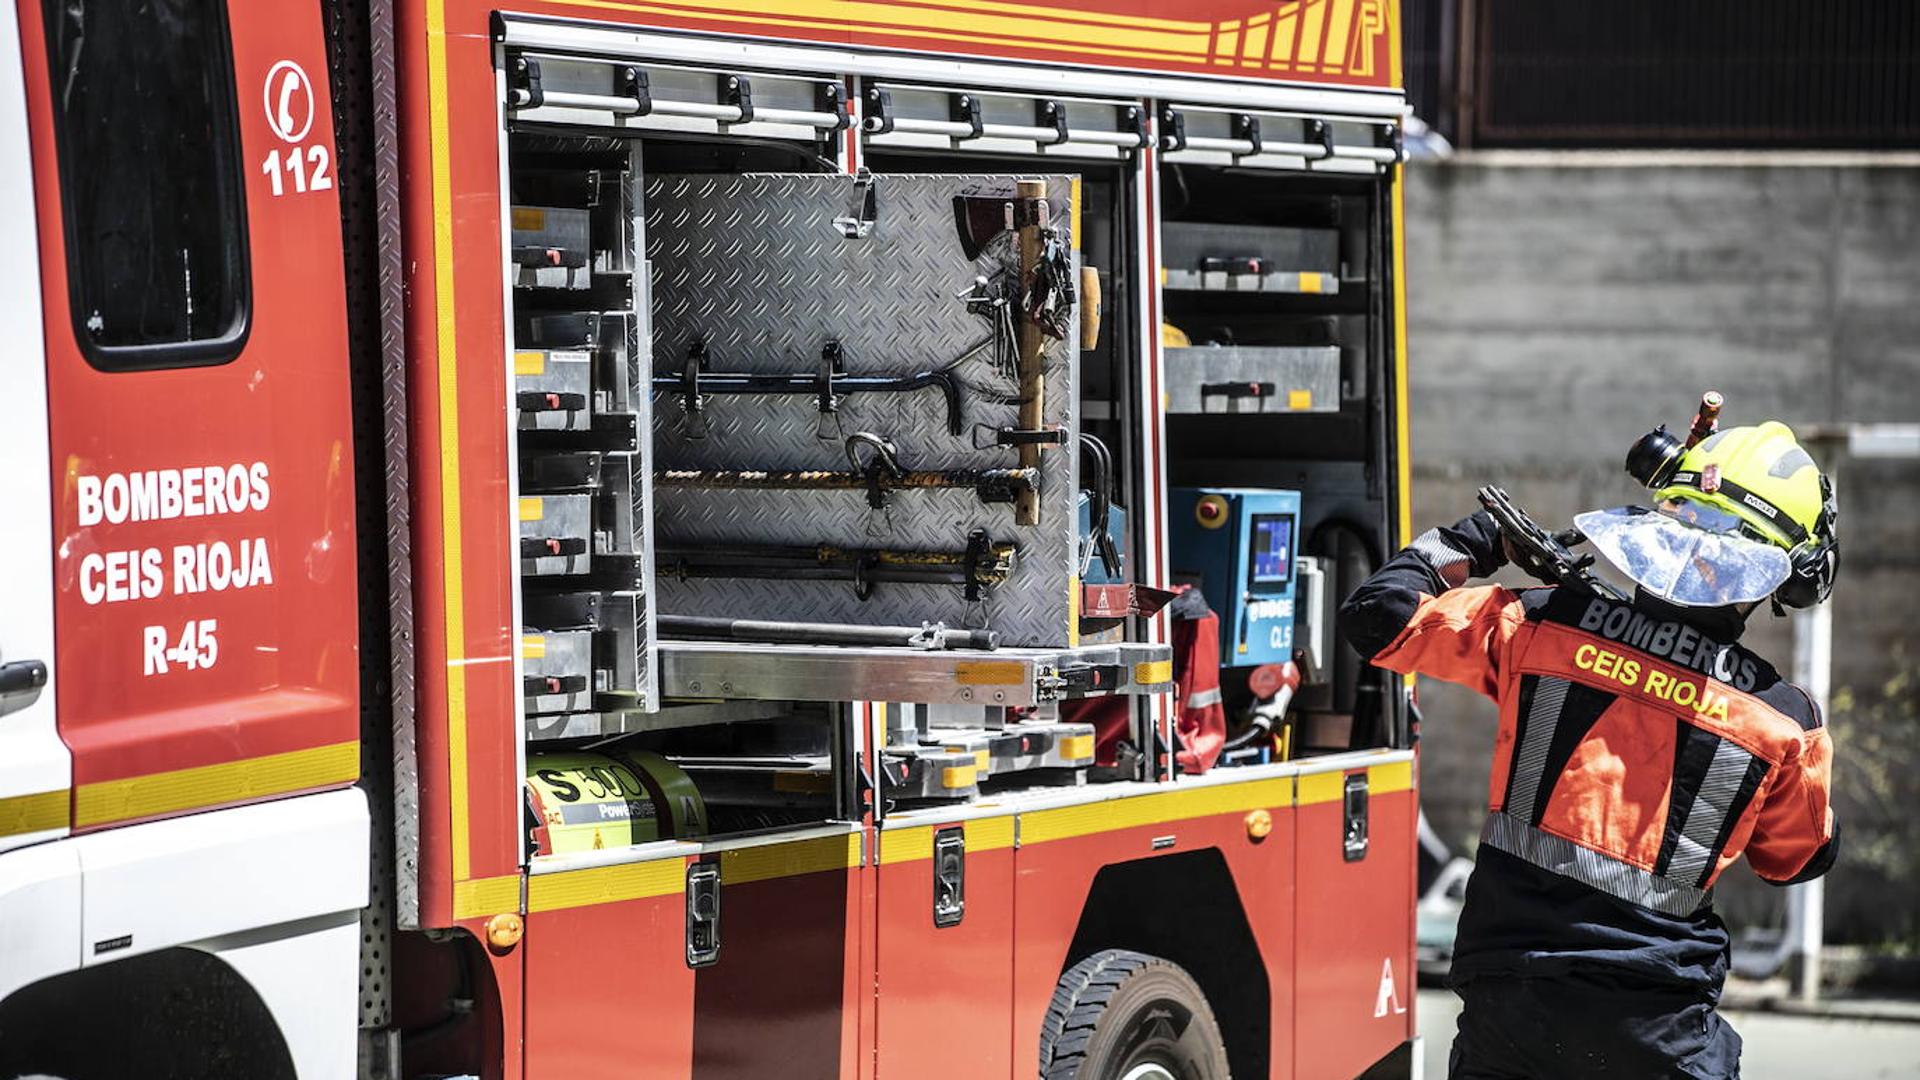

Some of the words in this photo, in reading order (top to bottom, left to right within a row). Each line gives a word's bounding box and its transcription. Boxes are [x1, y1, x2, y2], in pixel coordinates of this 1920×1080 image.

[262, 144, 332, 197] 112
[77, 461, 271, 527] BOMBEROS
[79, 547, 164, 605] CEIS
[173, 537, 273, 595] RIOJA
[143, 618, 218, 676] R-45
[1579, 600, 1758, 693] BOMBEROS
[1575, 644, 1641, 687] CEIS
[1643, 669, 1728, 722] RIOJA
